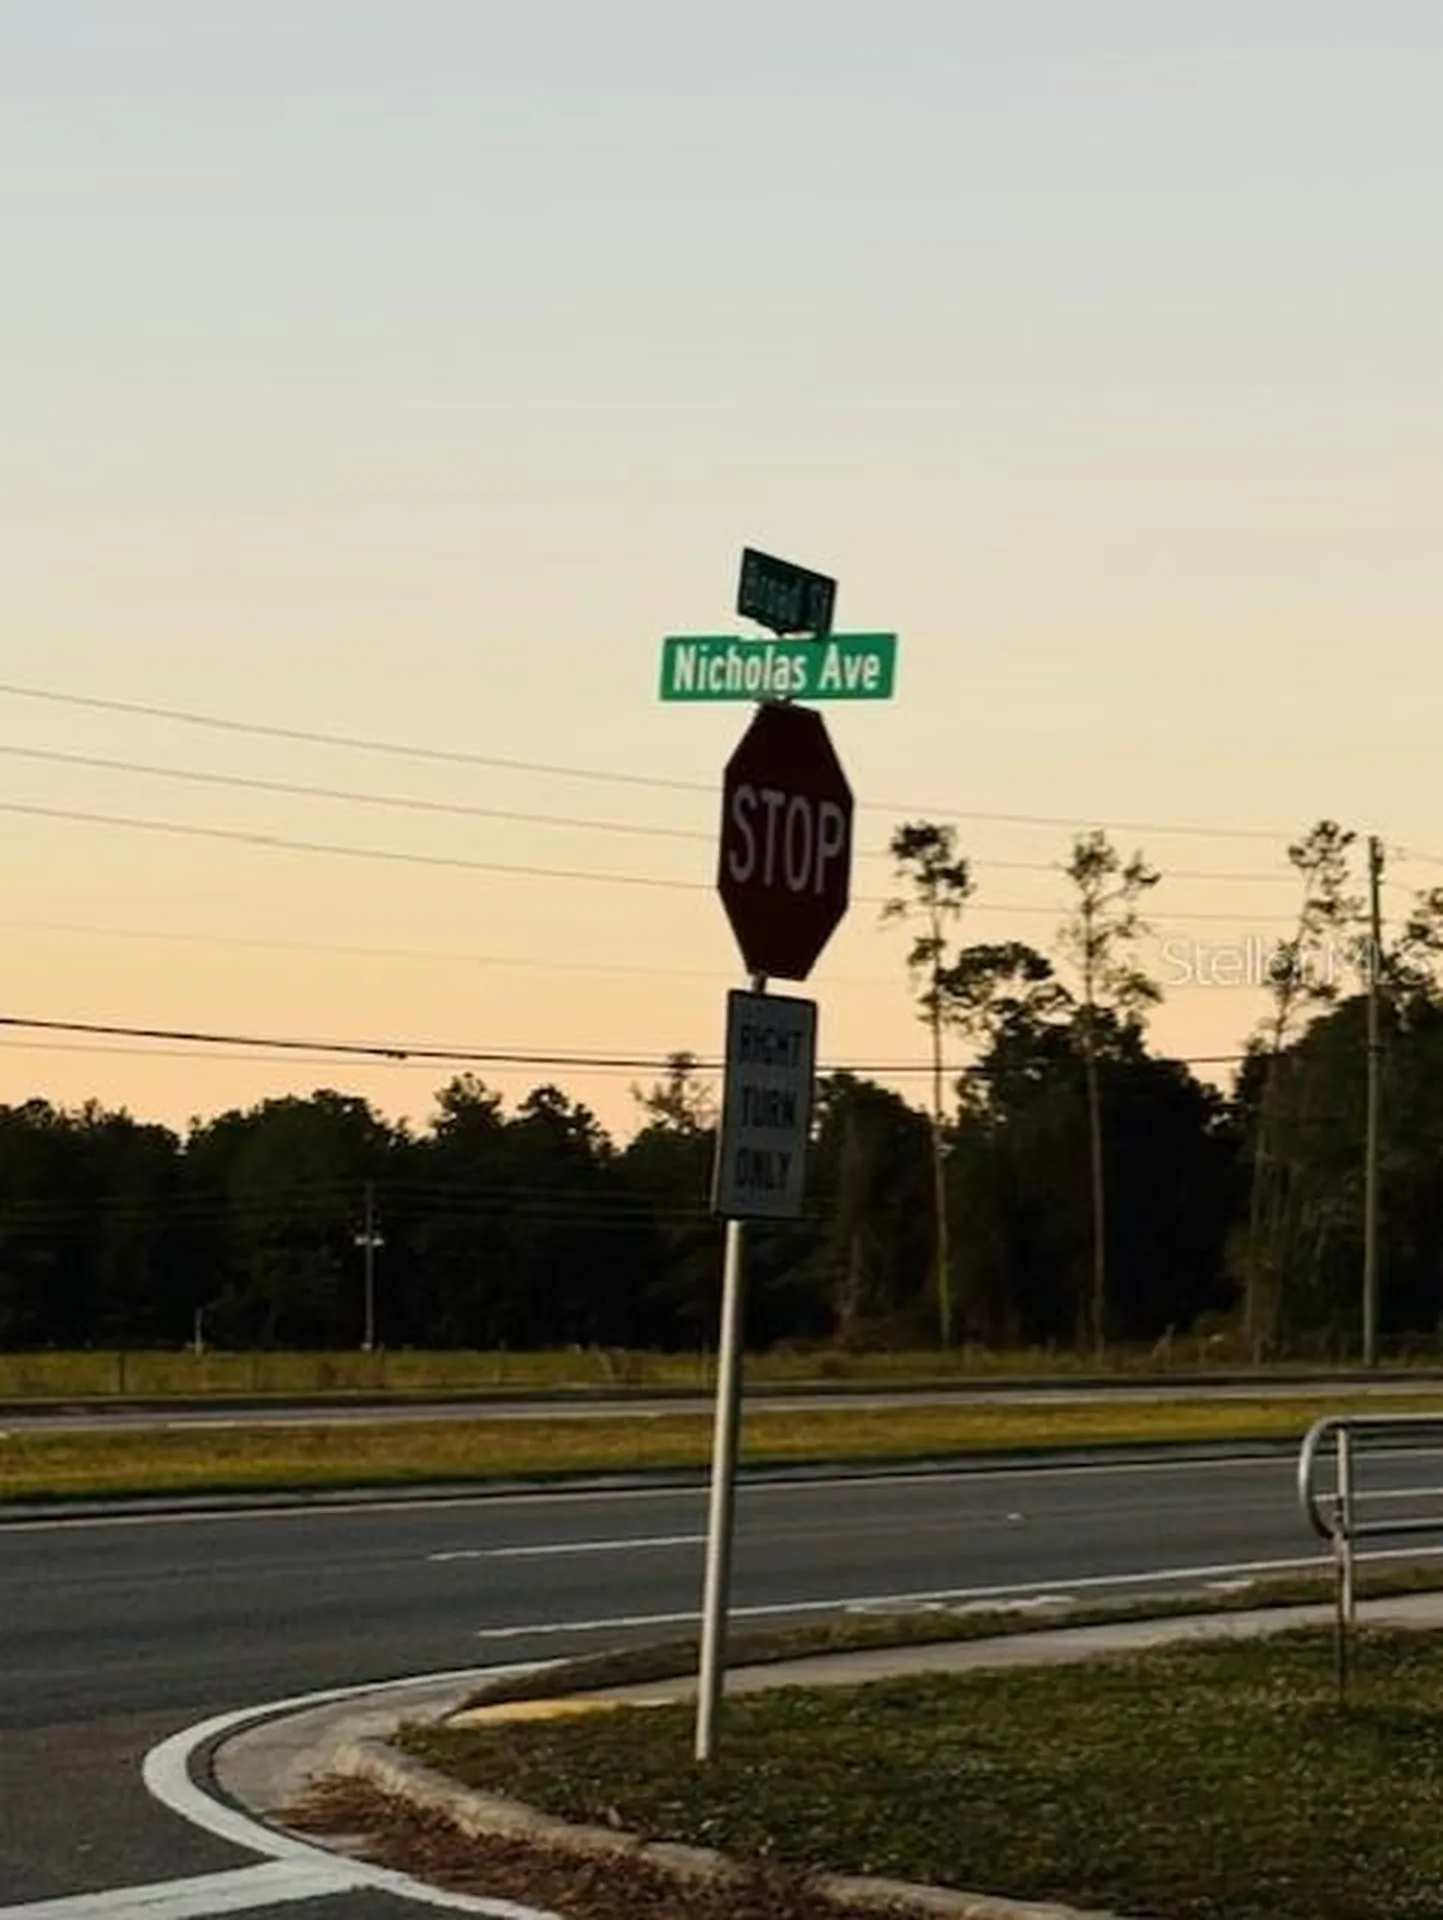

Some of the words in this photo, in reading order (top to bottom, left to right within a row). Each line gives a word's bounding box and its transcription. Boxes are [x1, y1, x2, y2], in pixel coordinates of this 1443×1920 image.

[673, 643, 806, 692] Nicholas
[818, 644, 881, 691] Ave
[728, 785, 845, 896] STOP
[737, 1023, 802, 1067] RIGHT
[740, 1085, 797, 1129] TURN
[734, 1146, 793, 1191] ONLY
